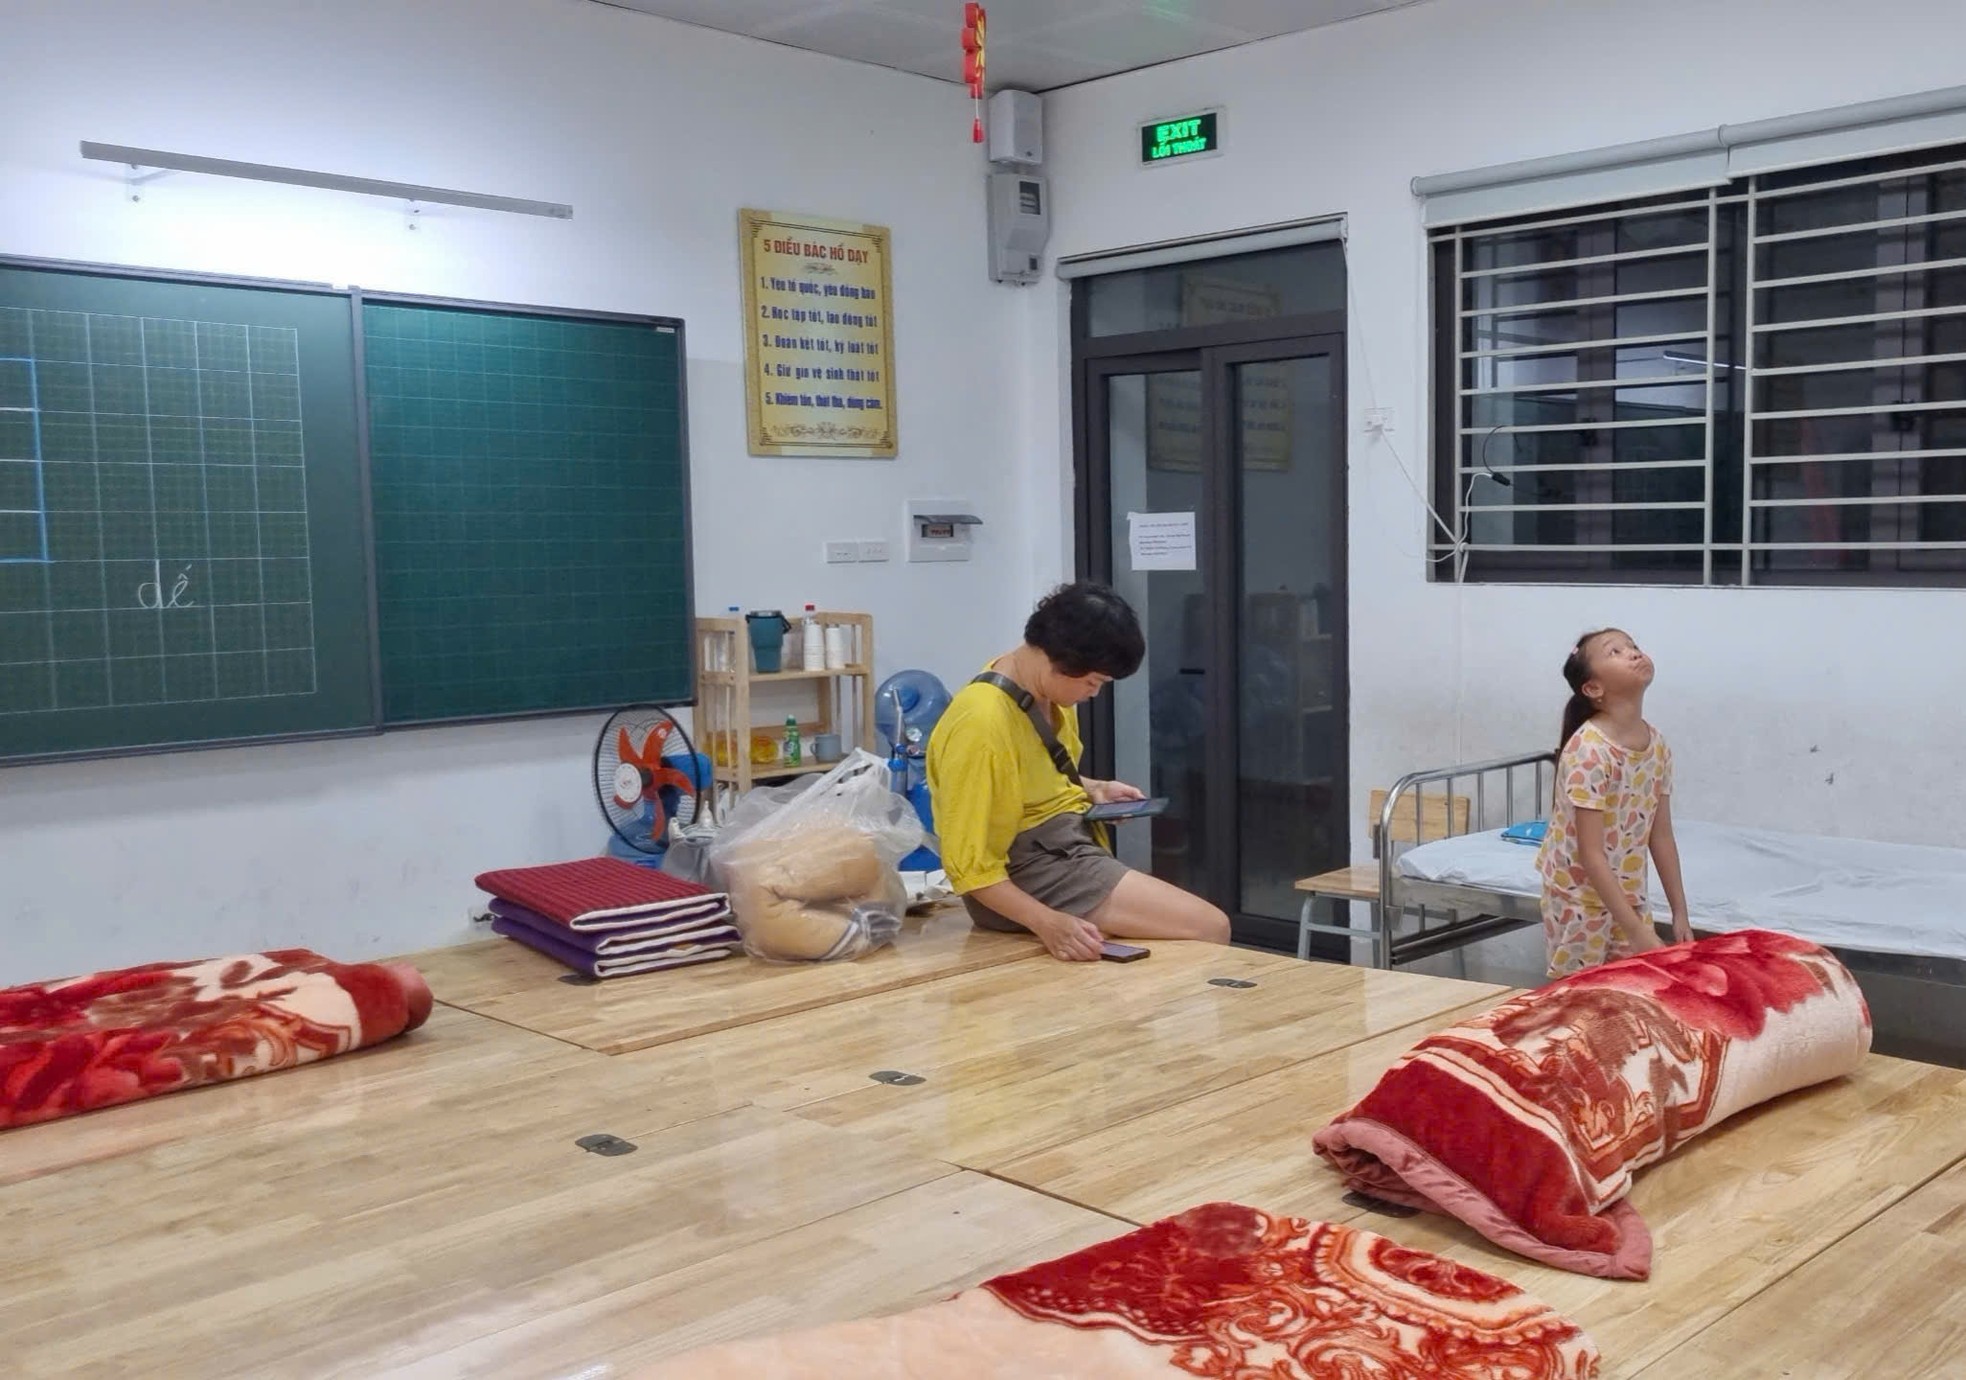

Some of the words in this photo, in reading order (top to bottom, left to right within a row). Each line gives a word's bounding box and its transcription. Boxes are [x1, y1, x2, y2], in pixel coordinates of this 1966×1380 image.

[1156, 119, 1202, 142] EXIT
[763, 239, 771, 253] 5
[805, 241, 827, 259] BÁC
[830, 243, 845, 261] HỒ
[848, 249, 869, 265] DẠY
[138, 560, 194, 609] dế
